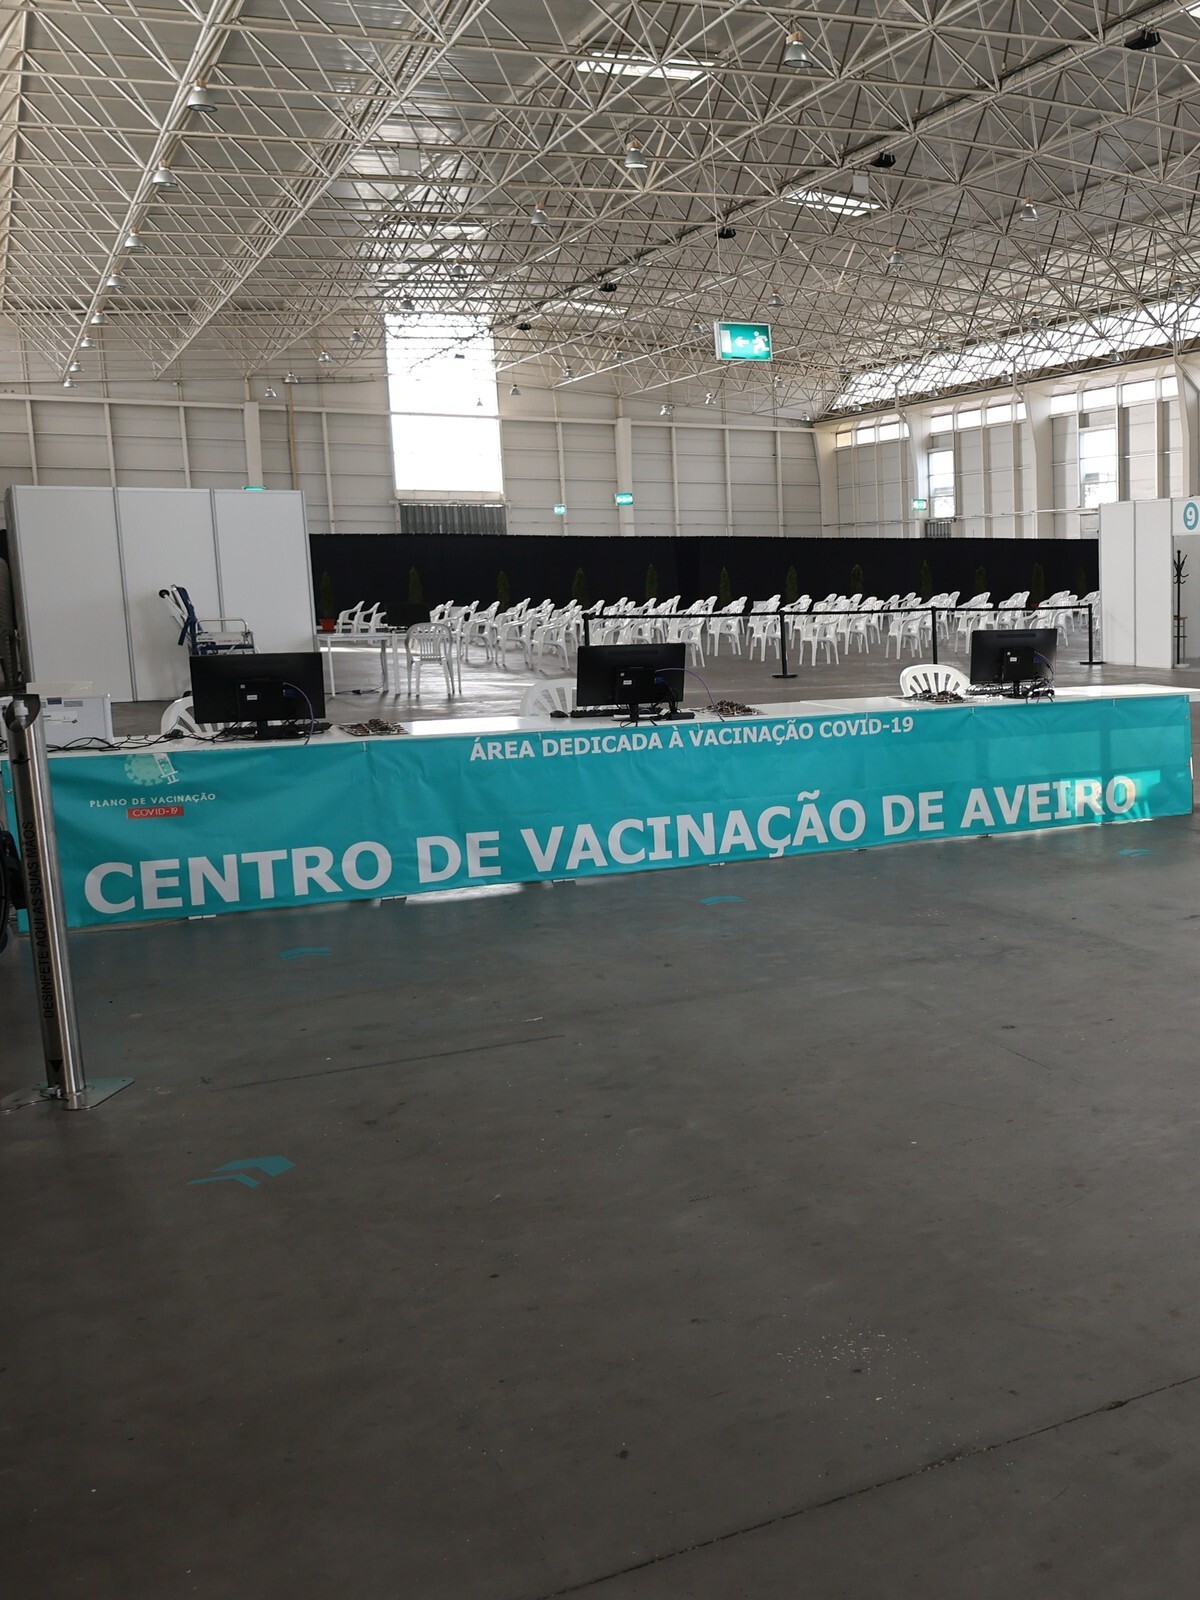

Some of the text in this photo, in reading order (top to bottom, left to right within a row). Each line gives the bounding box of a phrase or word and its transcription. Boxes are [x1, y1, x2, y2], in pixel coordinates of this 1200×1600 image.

[1186, 506, 1196, 526] 9
[470, 715, 915, 762] ÁREA DEDICADA À VACINAÇÃO COVID-19
[90, 792, 216, 808] PLANO DE VACINAÇÃO
[132, 807, 178, 817] COVID-19
[84, 774, 1137, 915] CENTRO DE VACINAÇÃO DE AVEIRO
[27, 862, 42, 895] SUAS
[32, 898, 44, 914] AS
[34, 918, 47, 948] AQUI
[38, 951, 54, 1018] DESINFETE
